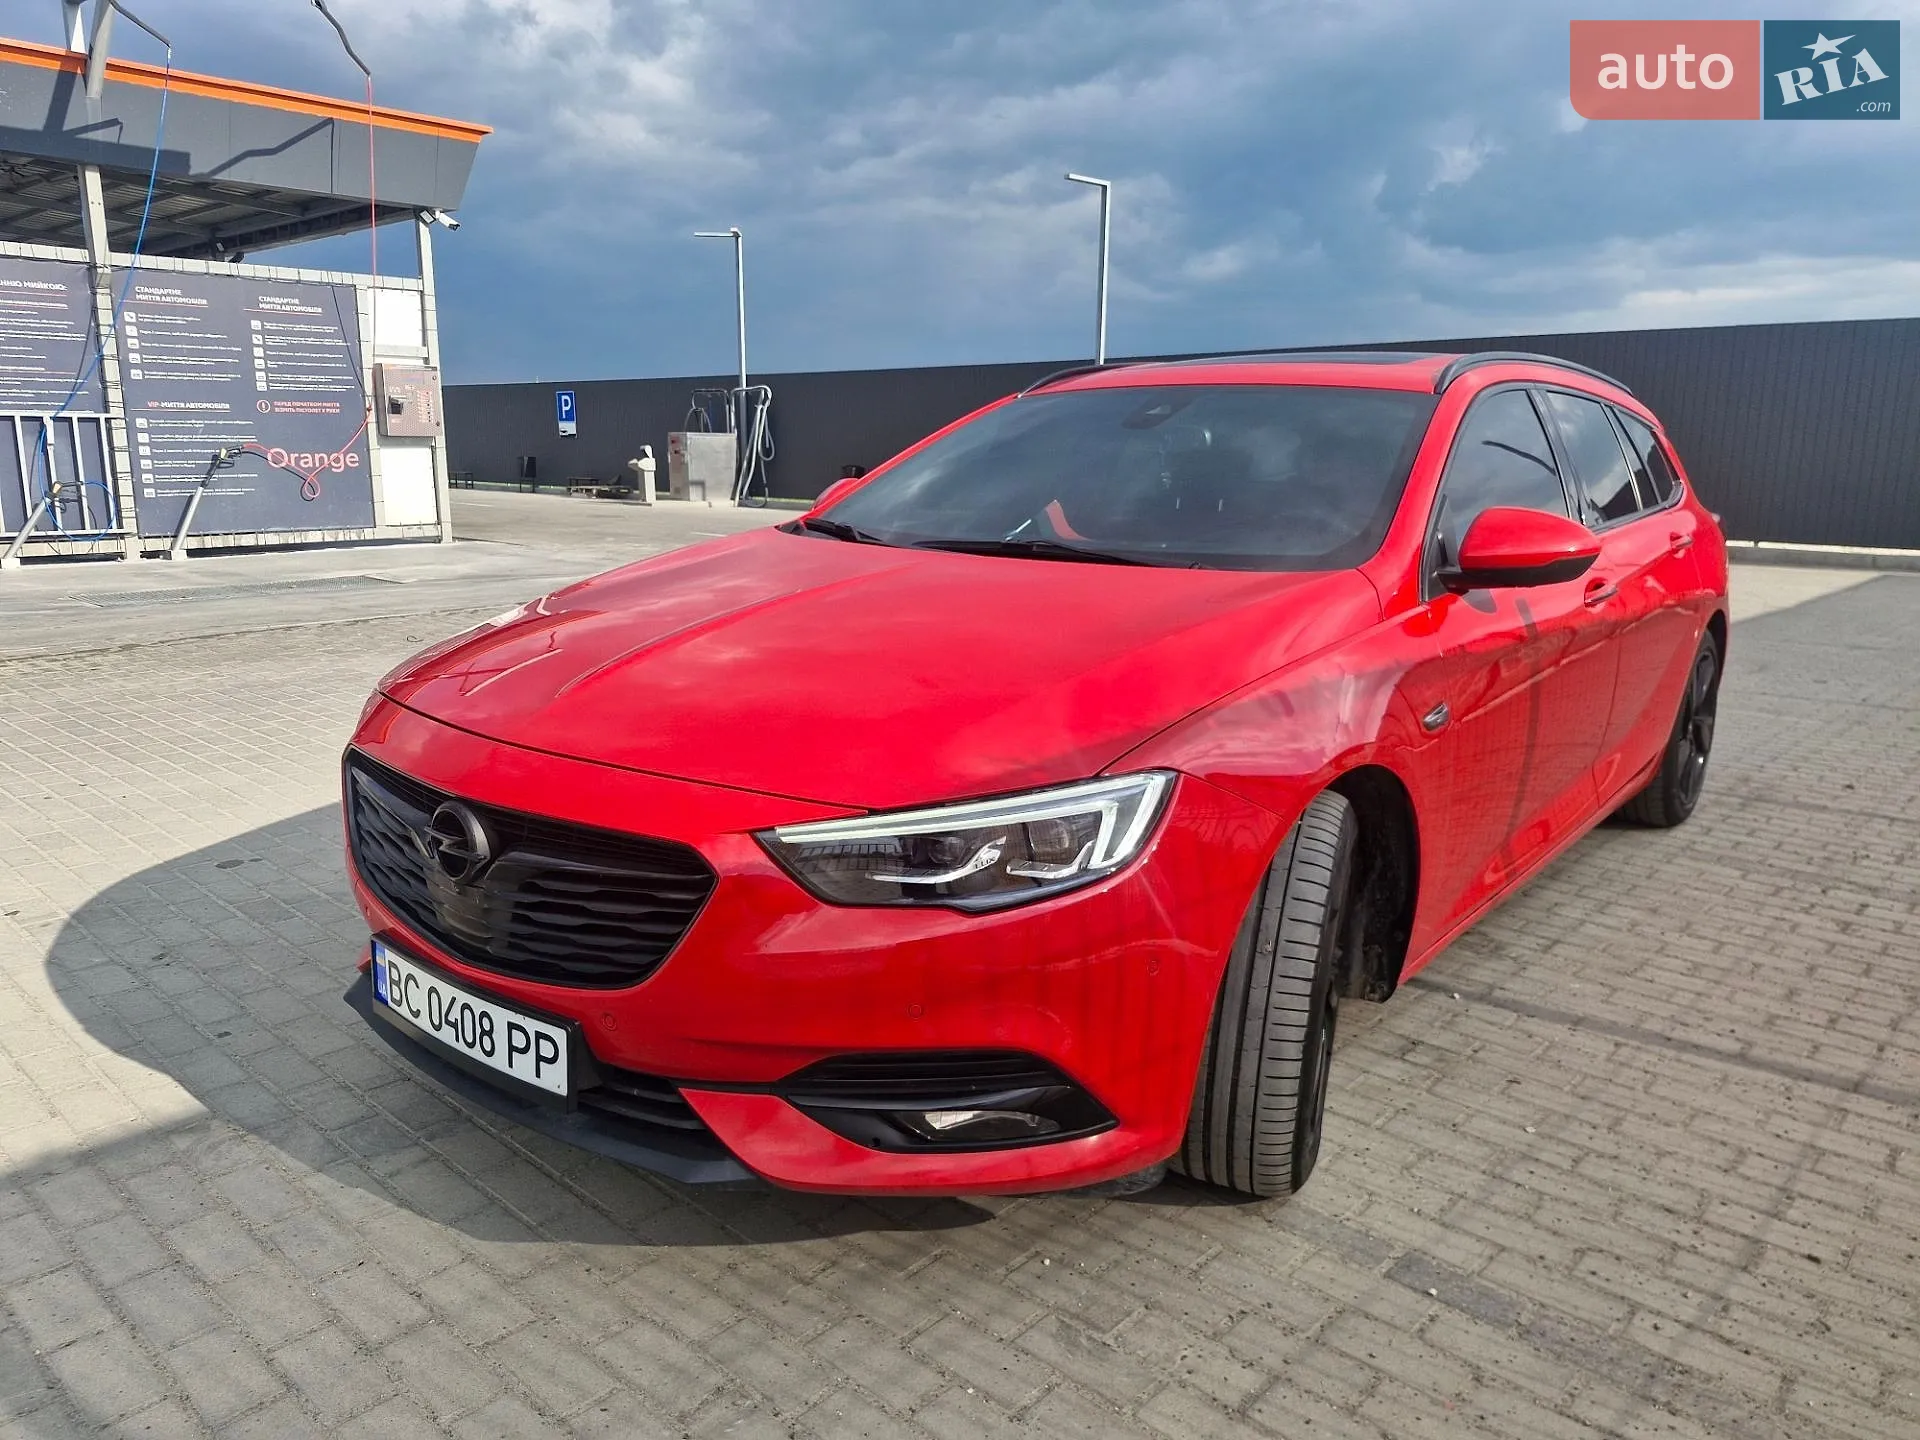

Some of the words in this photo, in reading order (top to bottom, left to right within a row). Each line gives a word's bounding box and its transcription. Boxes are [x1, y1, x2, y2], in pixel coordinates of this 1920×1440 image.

[135, 286, 182, 296] СТАНДАРТНЕ
[562, 395, 571, 418] P
[267, 447, 360, 473] Orange
[387, 961, 422, 1020] BC
[427, 986, 496, 1058] 0408
[506, 1020, 560, 1079] PP
